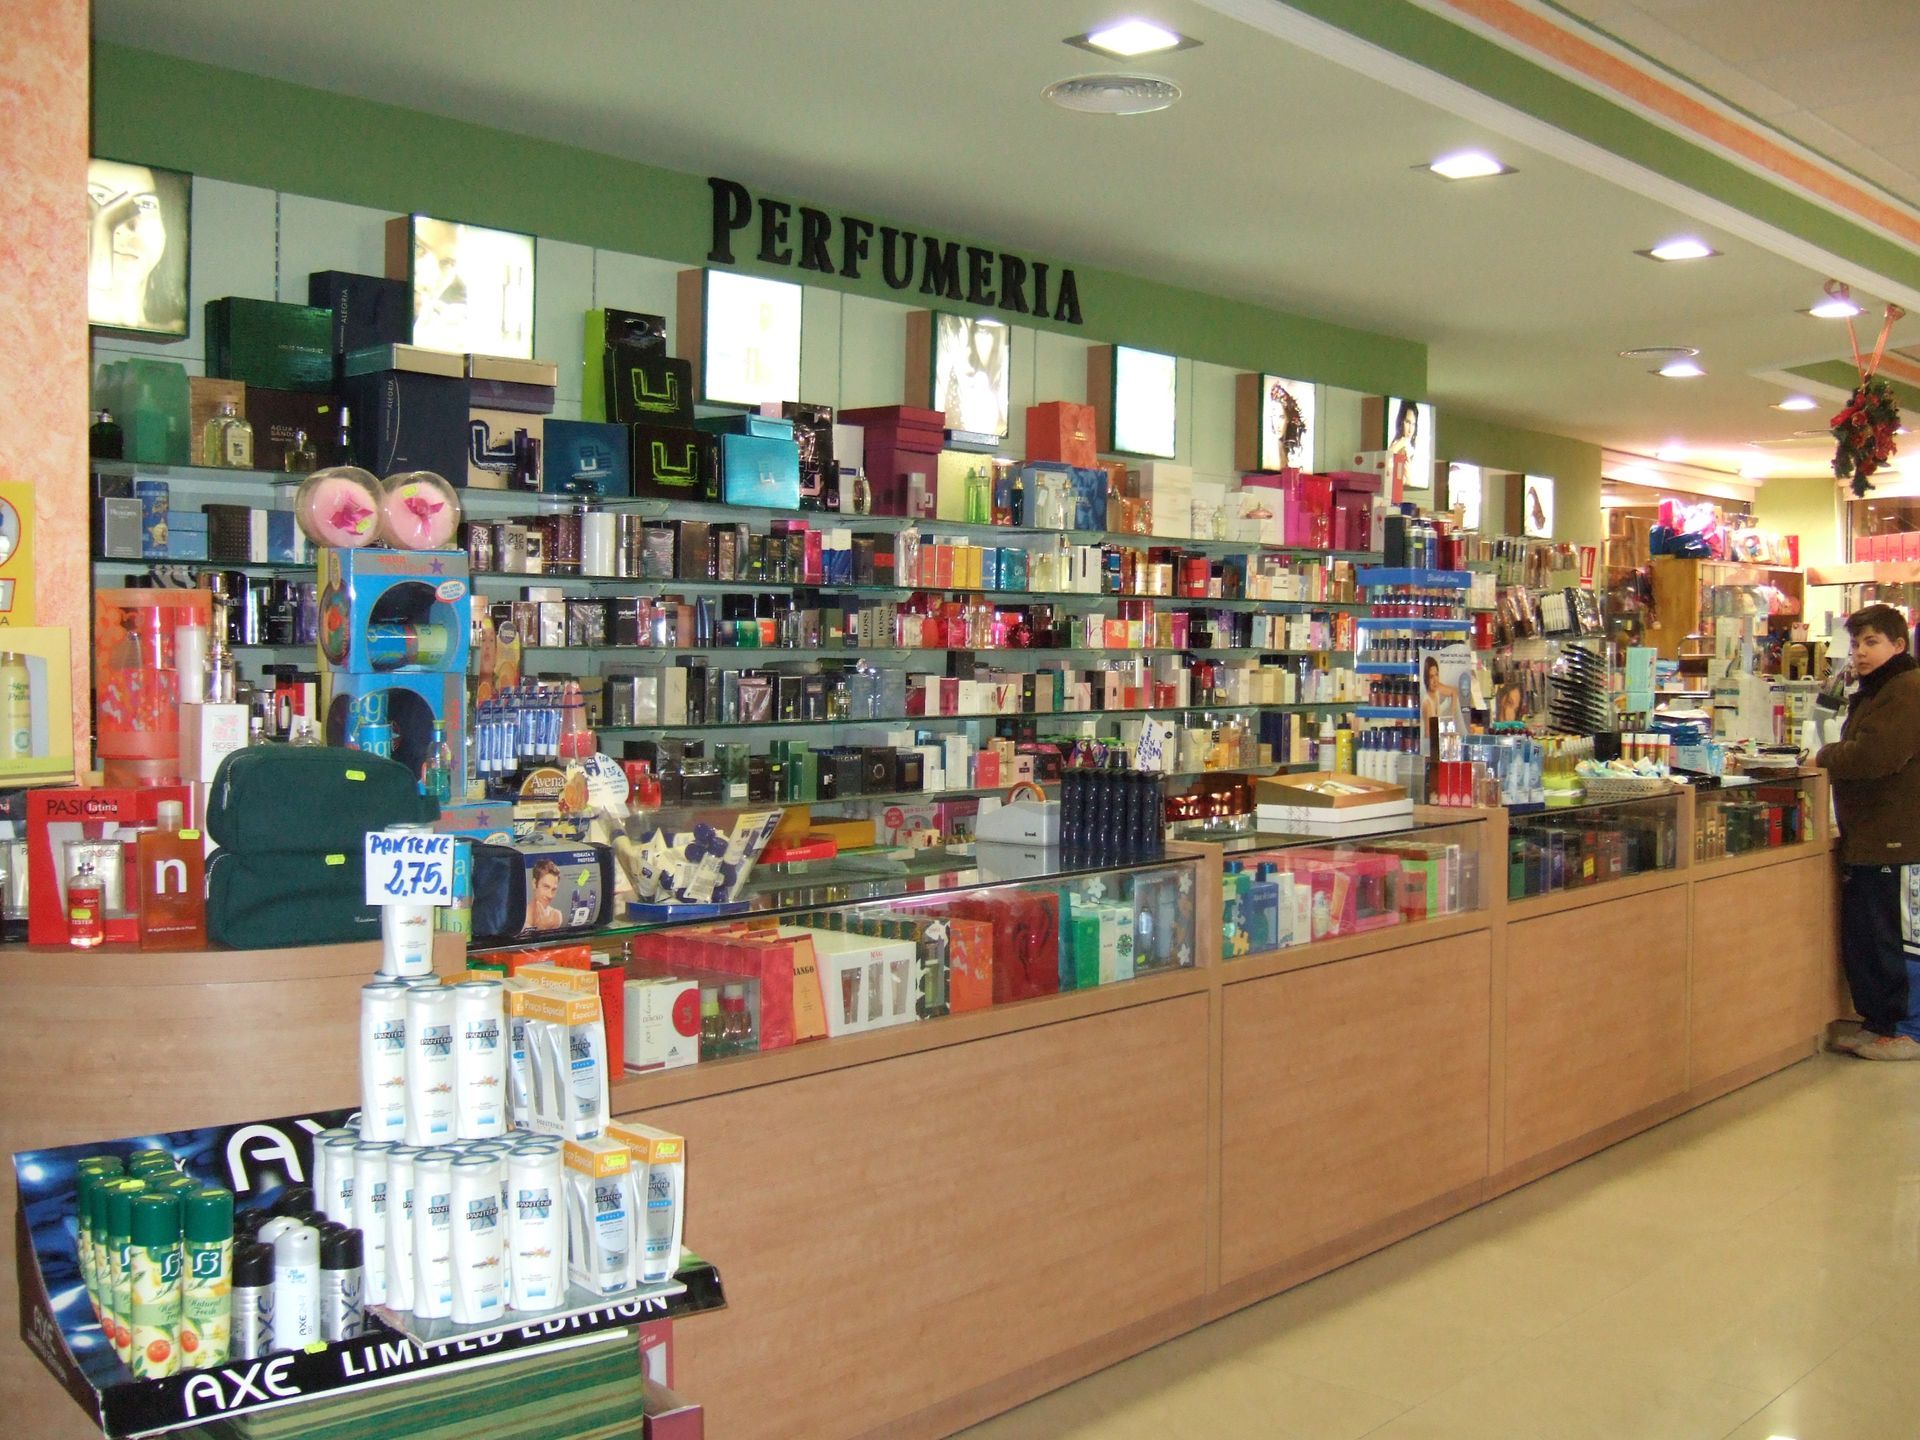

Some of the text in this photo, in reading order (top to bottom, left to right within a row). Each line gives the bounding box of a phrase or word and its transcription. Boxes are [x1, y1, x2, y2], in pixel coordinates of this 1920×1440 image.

[706, 176, 1083, 325] PERFUMERIA
[508, 532, 524, 544] 212
[530, 775, 564, 789] Avena
[88, 802, 118, 812] latina
[369, 834, 449, 855] PANTENE
[155, 858, 188, 894] n
[341, 1275, 362, 1341] AXE
[299, 1314, 307, 1336] AXE
[184, 1355, 302, 1418] AXE
